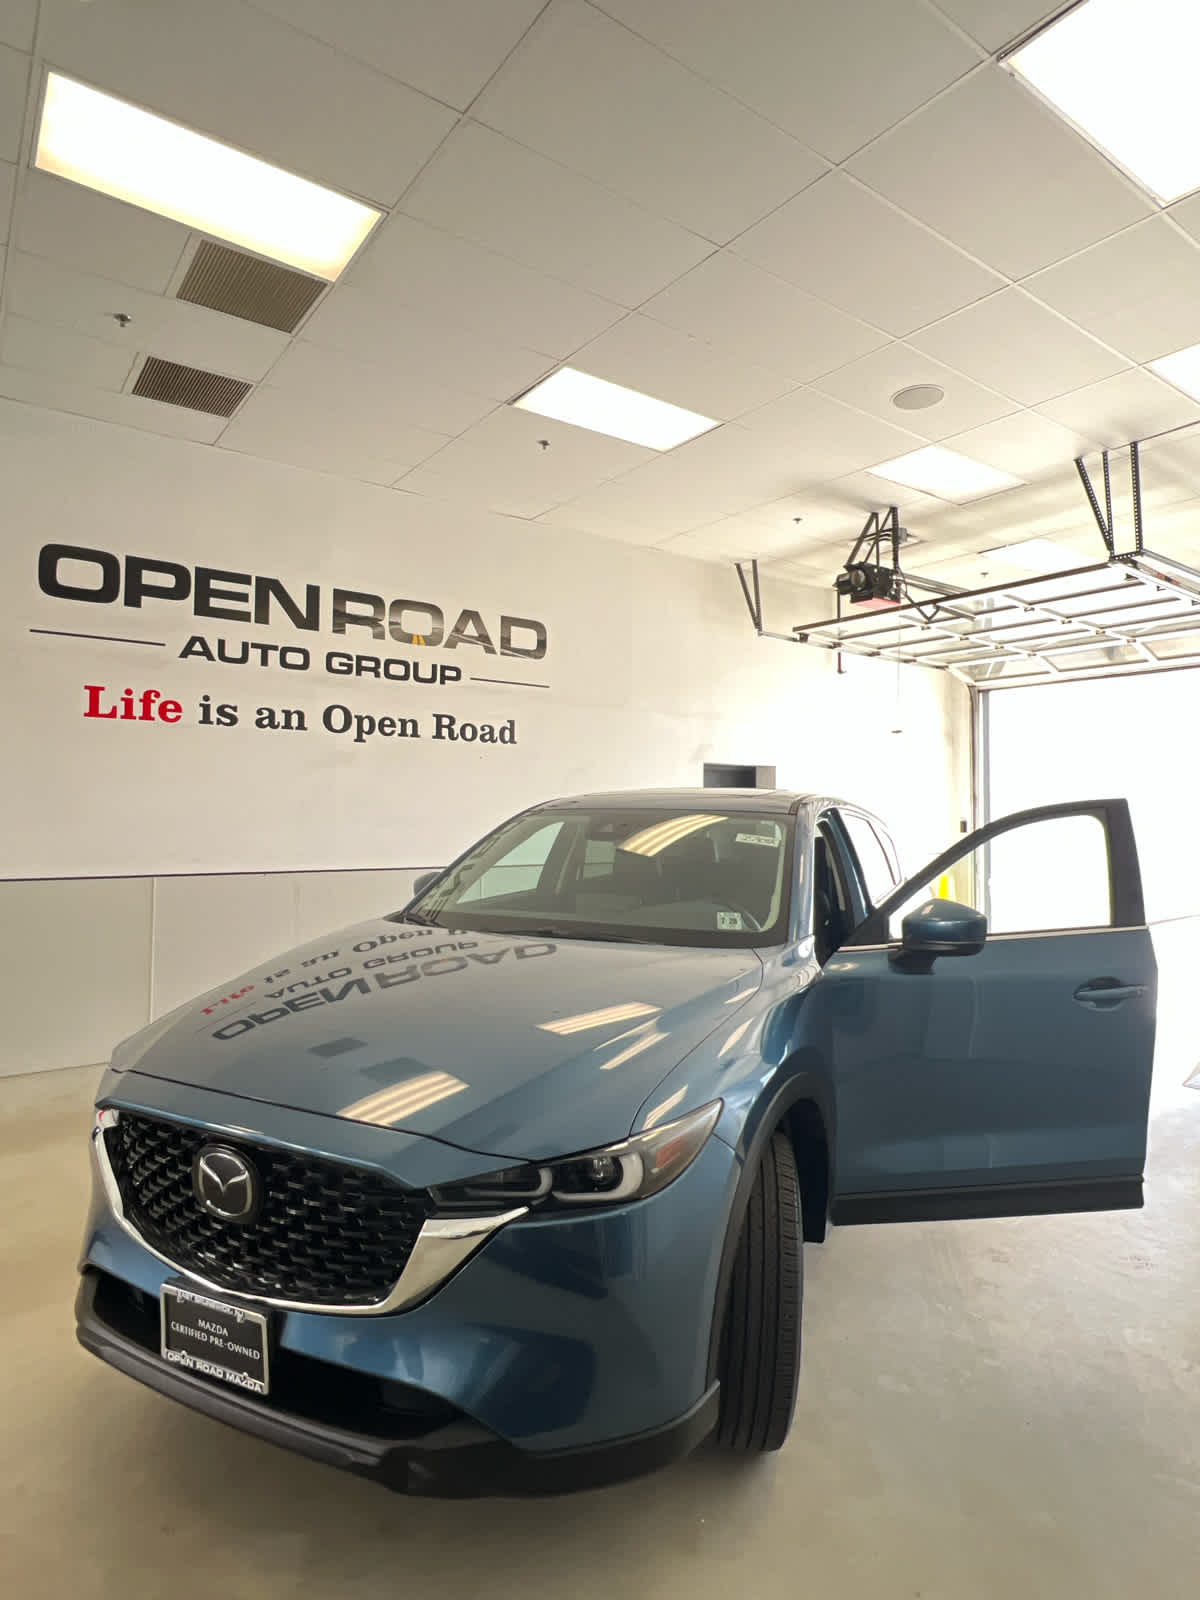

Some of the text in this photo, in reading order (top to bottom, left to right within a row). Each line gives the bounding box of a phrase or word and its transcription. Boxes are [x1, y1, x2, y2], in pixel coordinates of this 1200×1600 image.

[38, 543, 548, 660] OPEN ROAD
[179, 636, 462, 685] AUTO GROUP
[83, 685, 517, 745] Life is an Open Road
[170, 1321, 261, 1360] CERTIFIED PRE-OWNED
[198, 1319, 228, 1336] MAZDA
[167, 1352, 262, 1392] OPEN ROAD MAZDA
